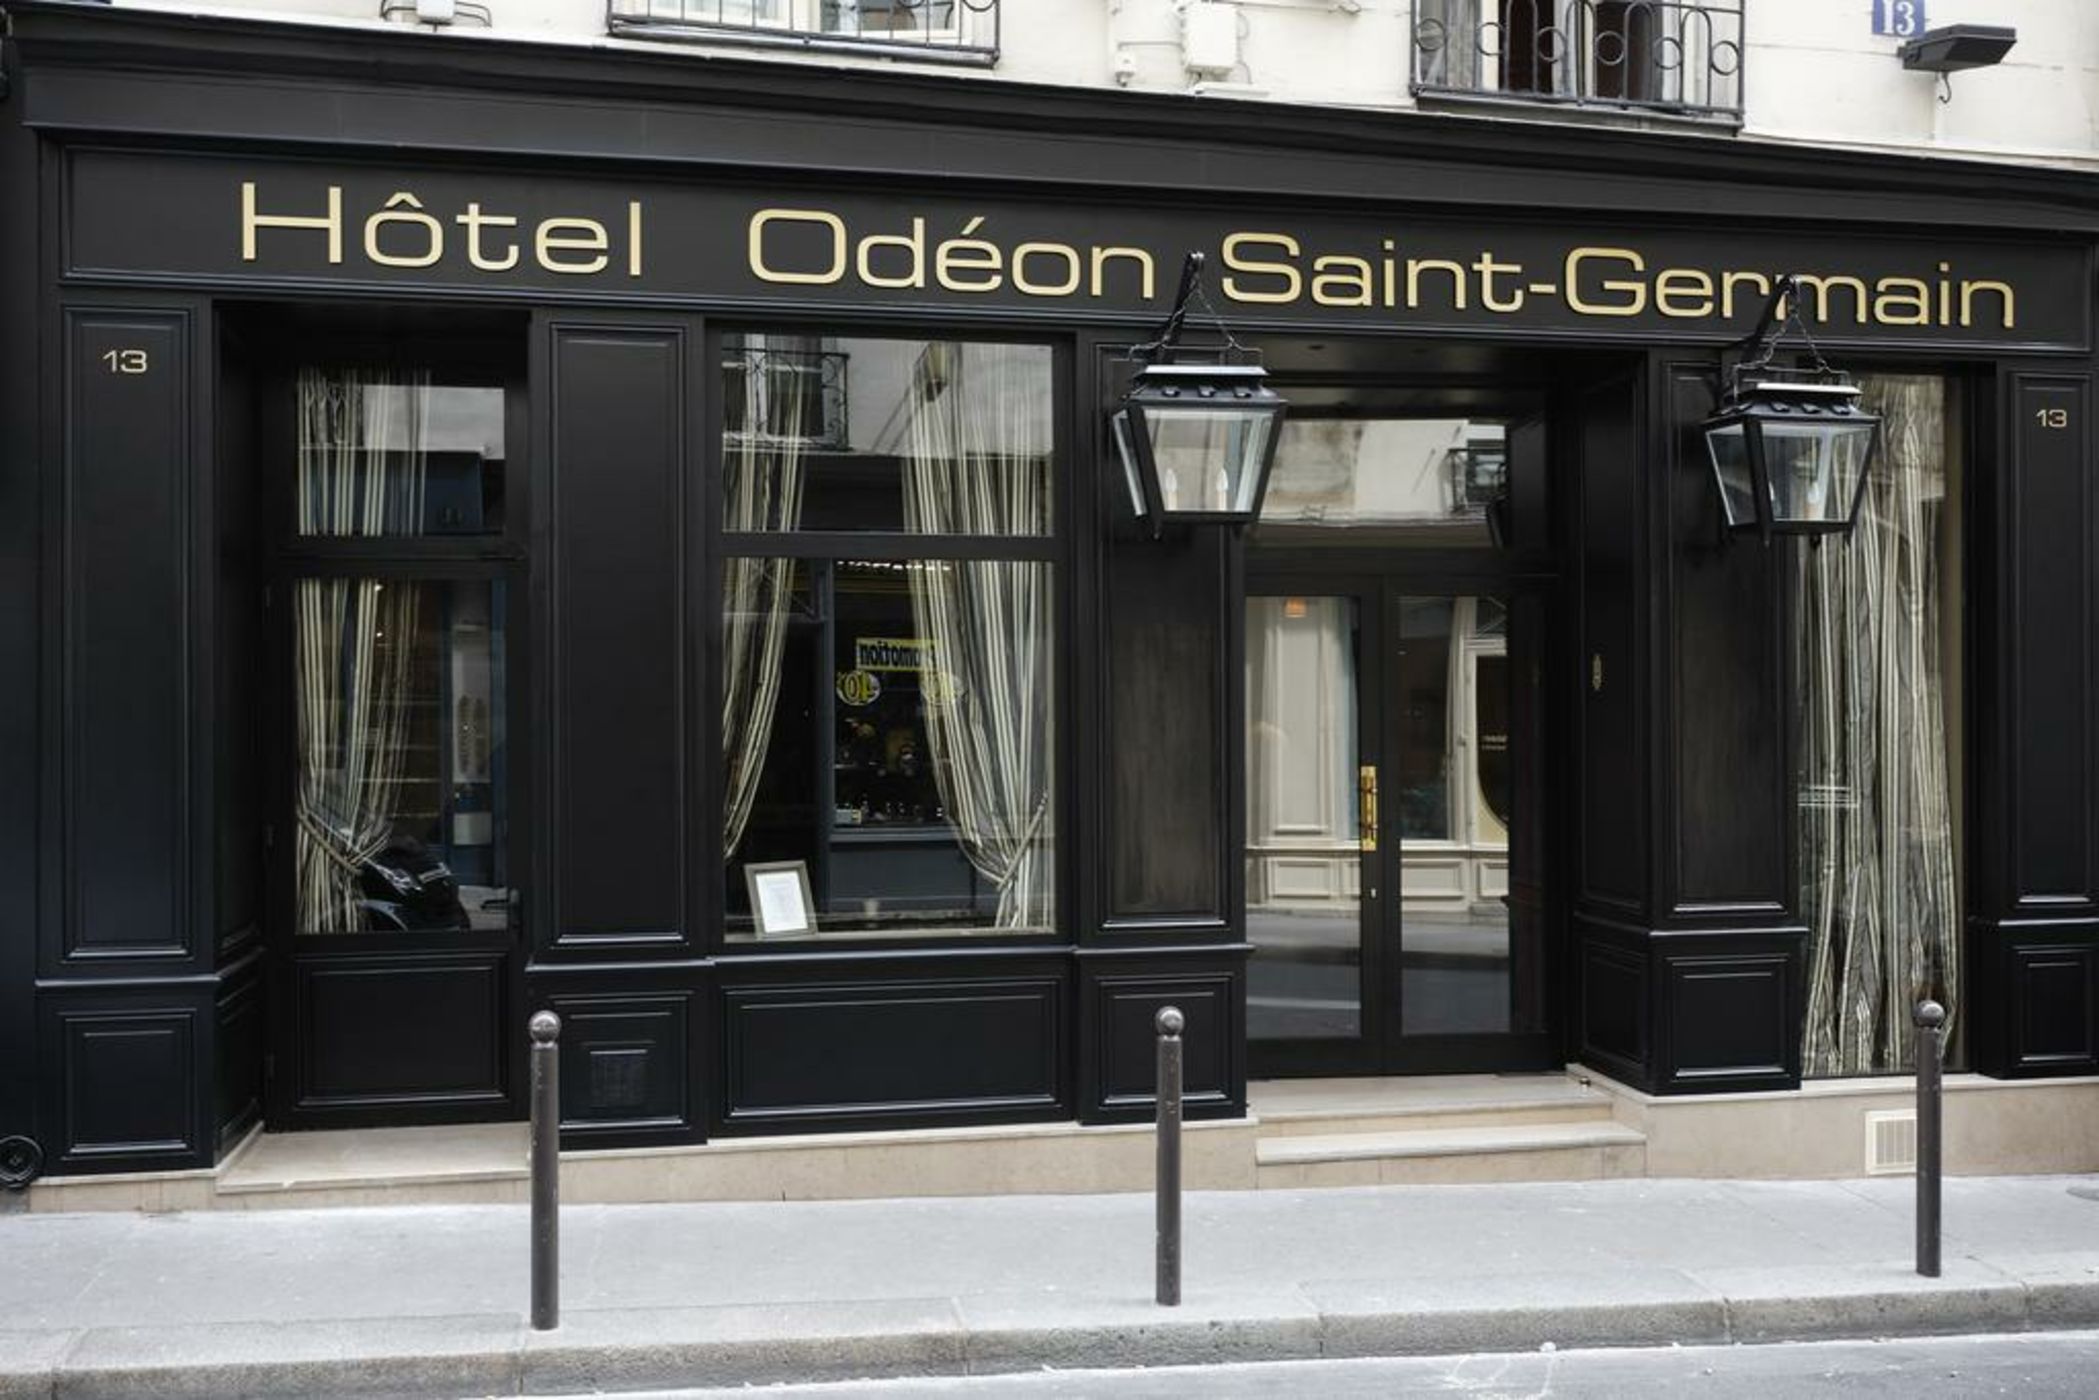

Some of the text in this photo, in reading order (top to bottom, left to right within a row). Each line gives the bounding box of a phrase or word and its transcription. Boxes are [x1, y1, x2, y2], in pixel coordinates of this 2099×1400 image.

[1883, 0, 1915, 35] 13
[240, 182, 2015, 328] Hôtel Odéon Saint-Germain
[102, 349, 148, 373] 13
[2035, 408, 2067, 427] 13
